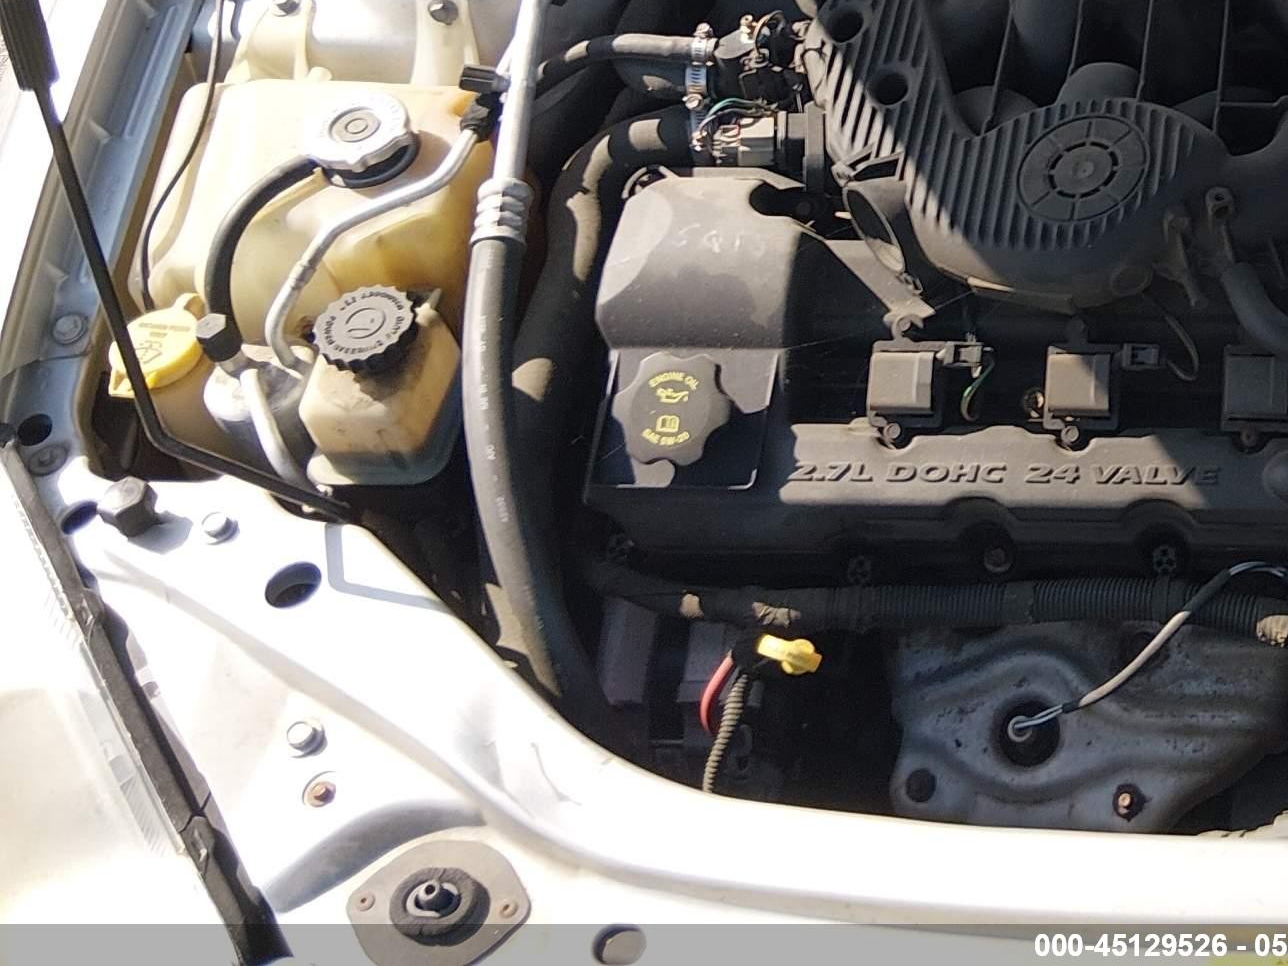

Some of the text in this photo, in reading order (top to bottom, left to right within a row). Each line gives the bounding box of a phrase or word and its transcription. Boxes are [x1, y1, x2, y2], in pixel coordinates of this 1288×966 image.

[648, 372, 699, 390] ENGINE OIL
[642, 428, 661, 444] SAE
[787, 461, 1222, 485] 2.7L DOHC 24 VALVE
